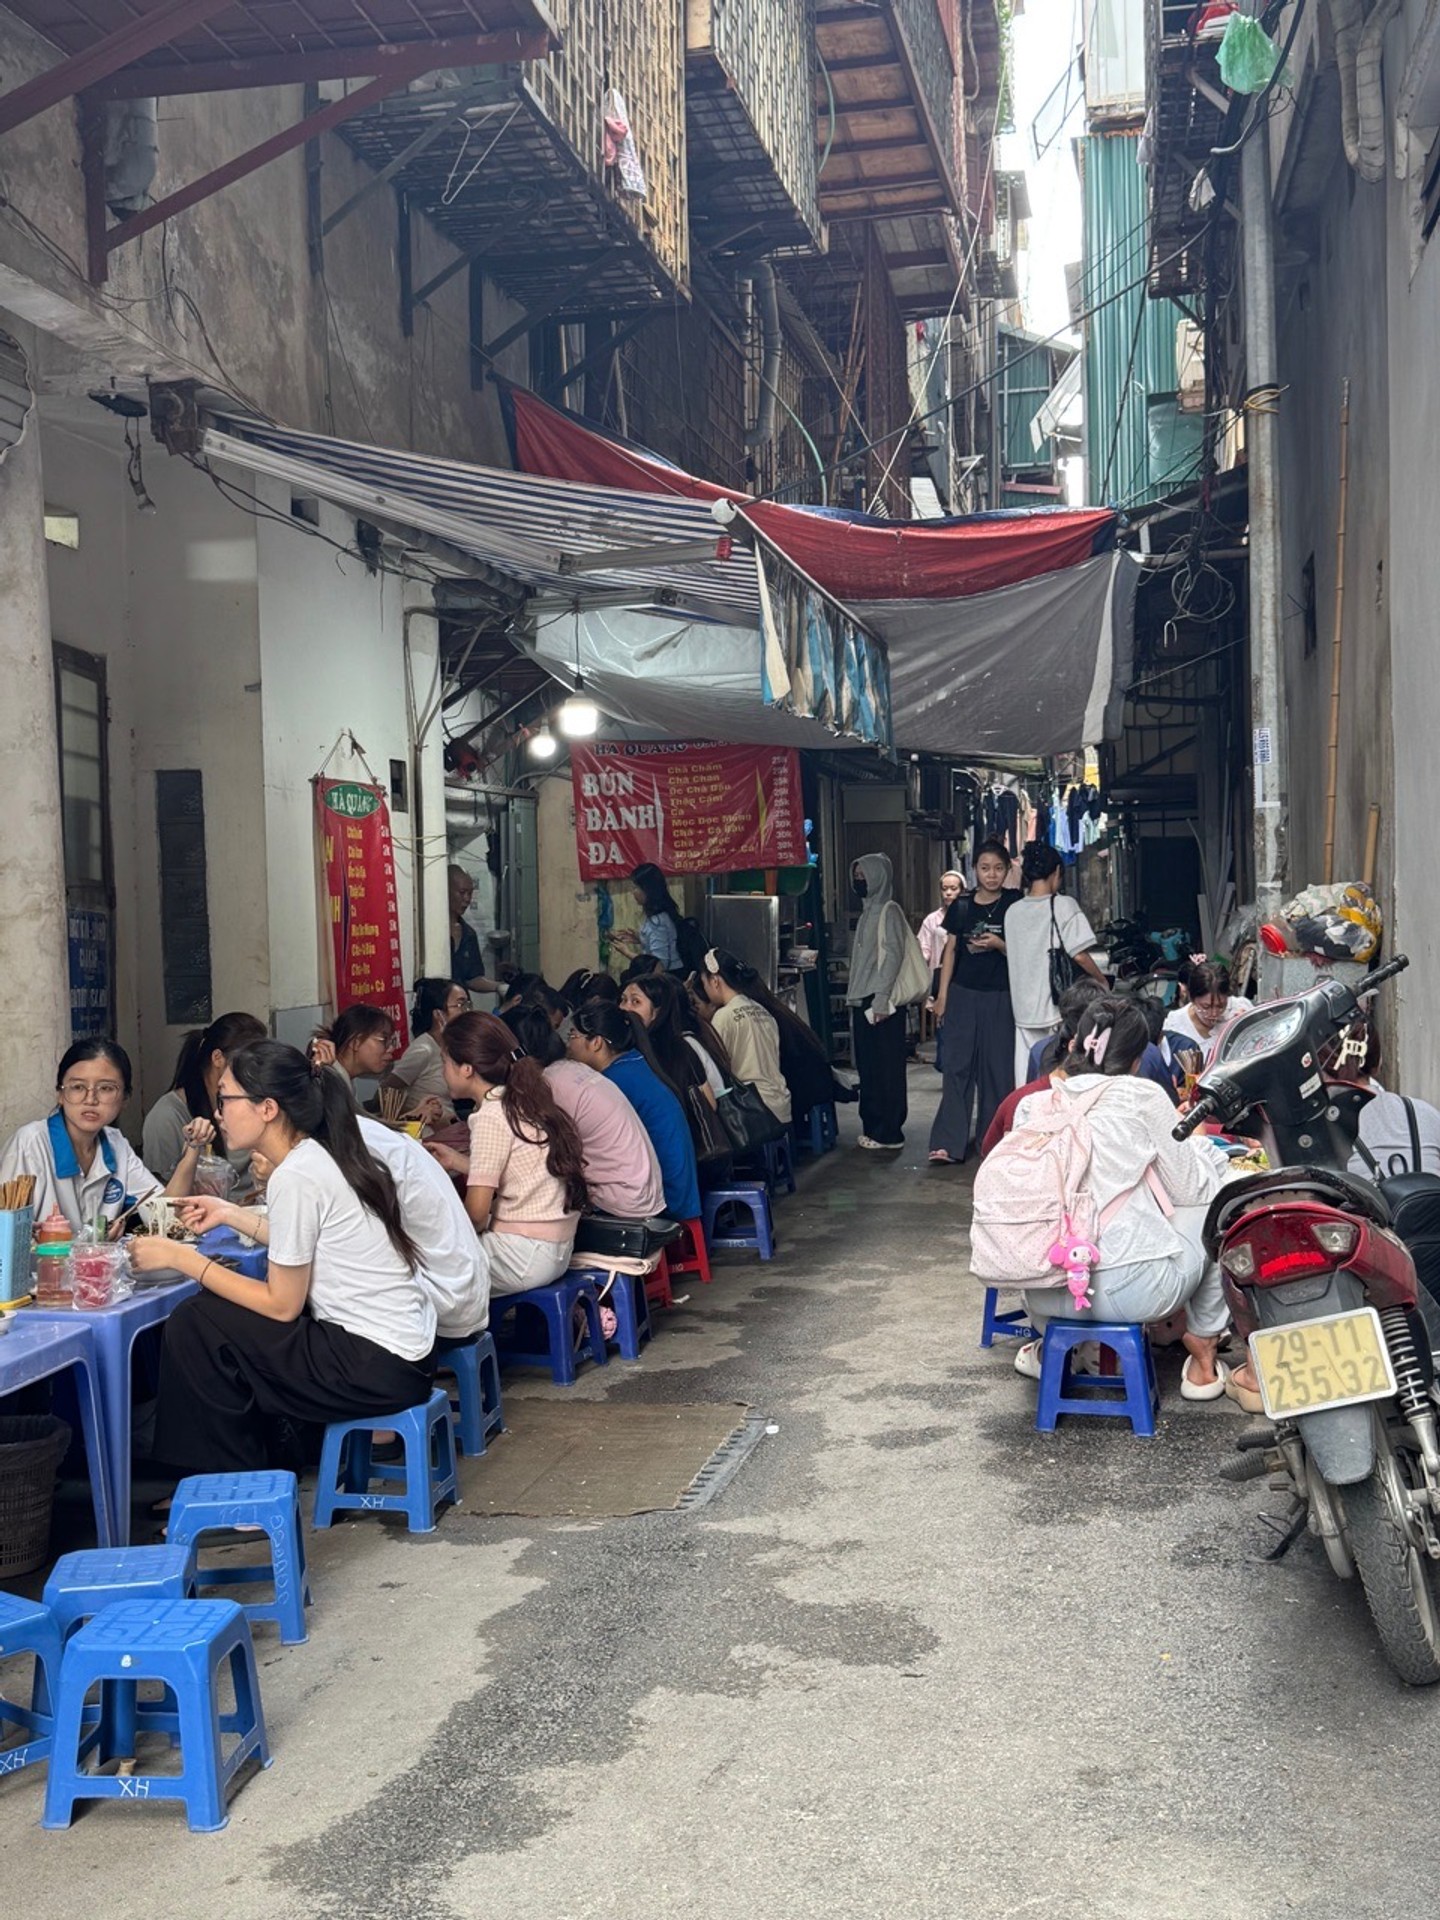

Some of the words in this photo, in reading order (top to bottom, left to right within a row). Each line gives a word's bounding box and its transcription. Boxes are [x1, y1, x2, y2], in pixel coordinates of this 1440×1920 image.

[582, 765, 635, 797] BÚN
[586, 800, 656, 832] BÁNH
[588, 841, 625, 866] ĐA
[1270, 1318, 1362, 1366] 29-T1
[1269, 1355, 1386, 1413] 255.32
[360, 1496, 386, 1509] XH
[0, 1748, 28, 1774] XH
[118, 1778, 150, 1799] XH
